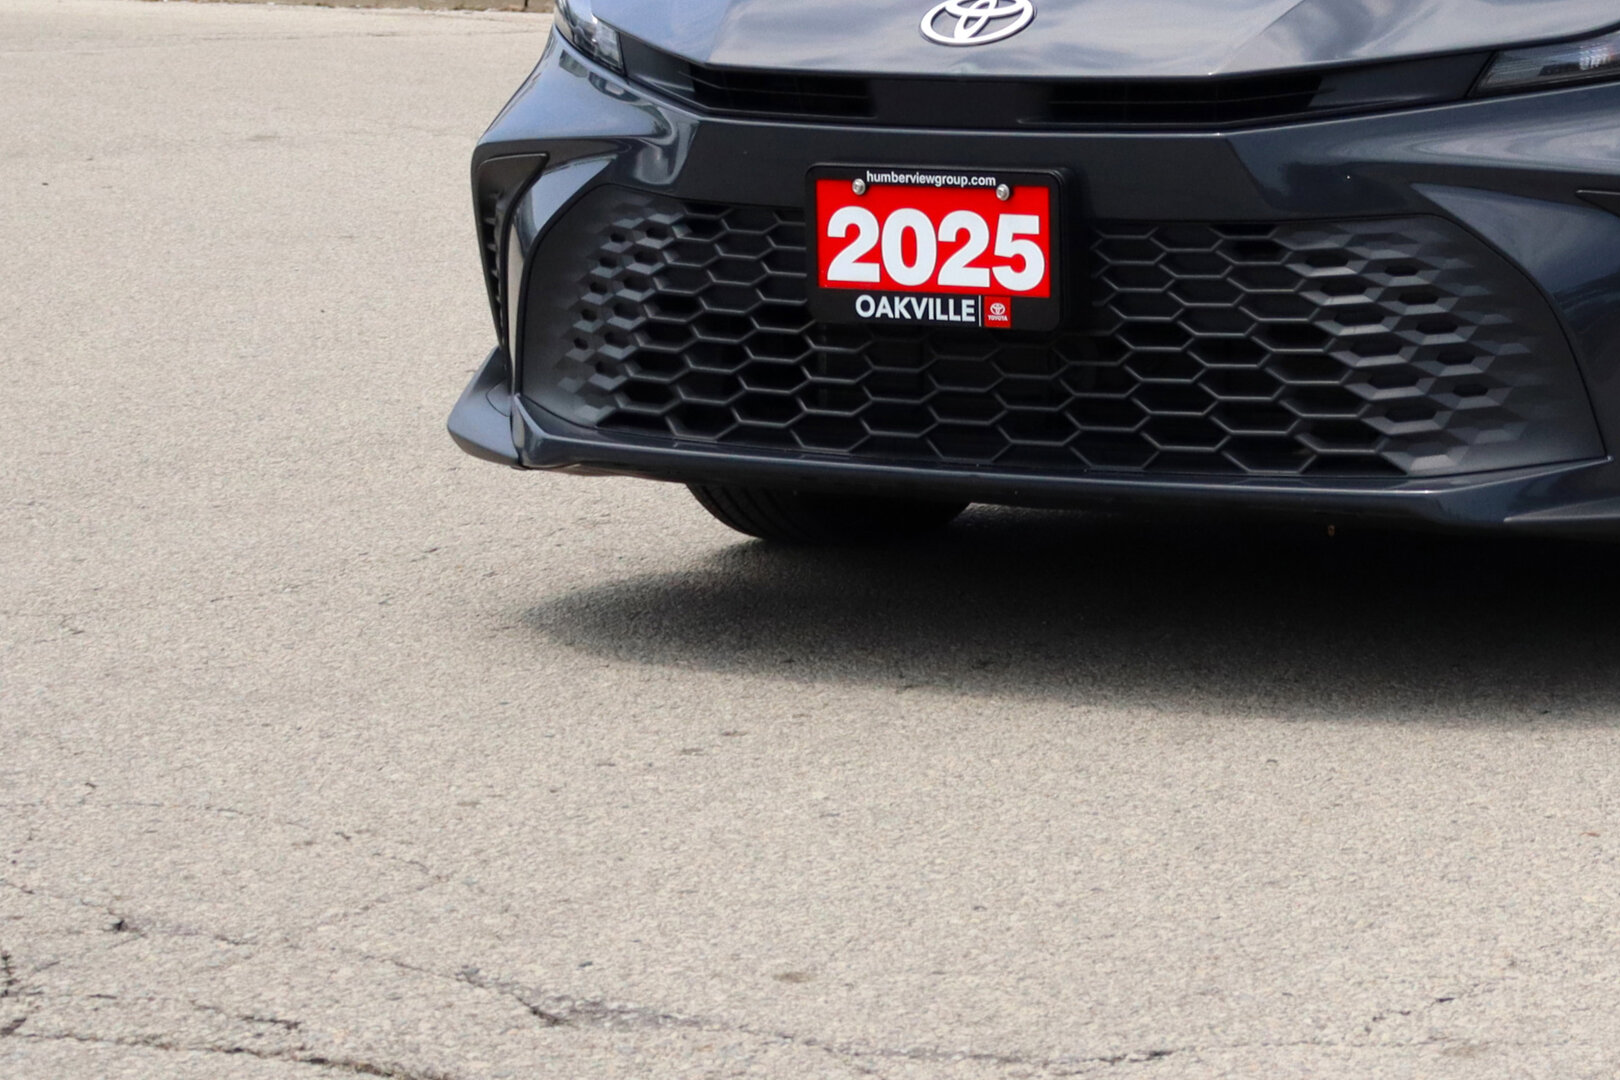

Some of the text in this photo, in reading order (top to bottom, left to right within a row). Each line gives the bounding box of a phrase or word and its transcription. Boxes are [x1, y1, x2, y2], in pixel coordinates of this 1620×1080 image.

[865, 170, 997, 188] humberviewgroup.com
[826, 205, 1046, 292] 2025
[855, 294, 976, 323] OAKVILLE
[987, 314, 1009, 322] TOYOTA
